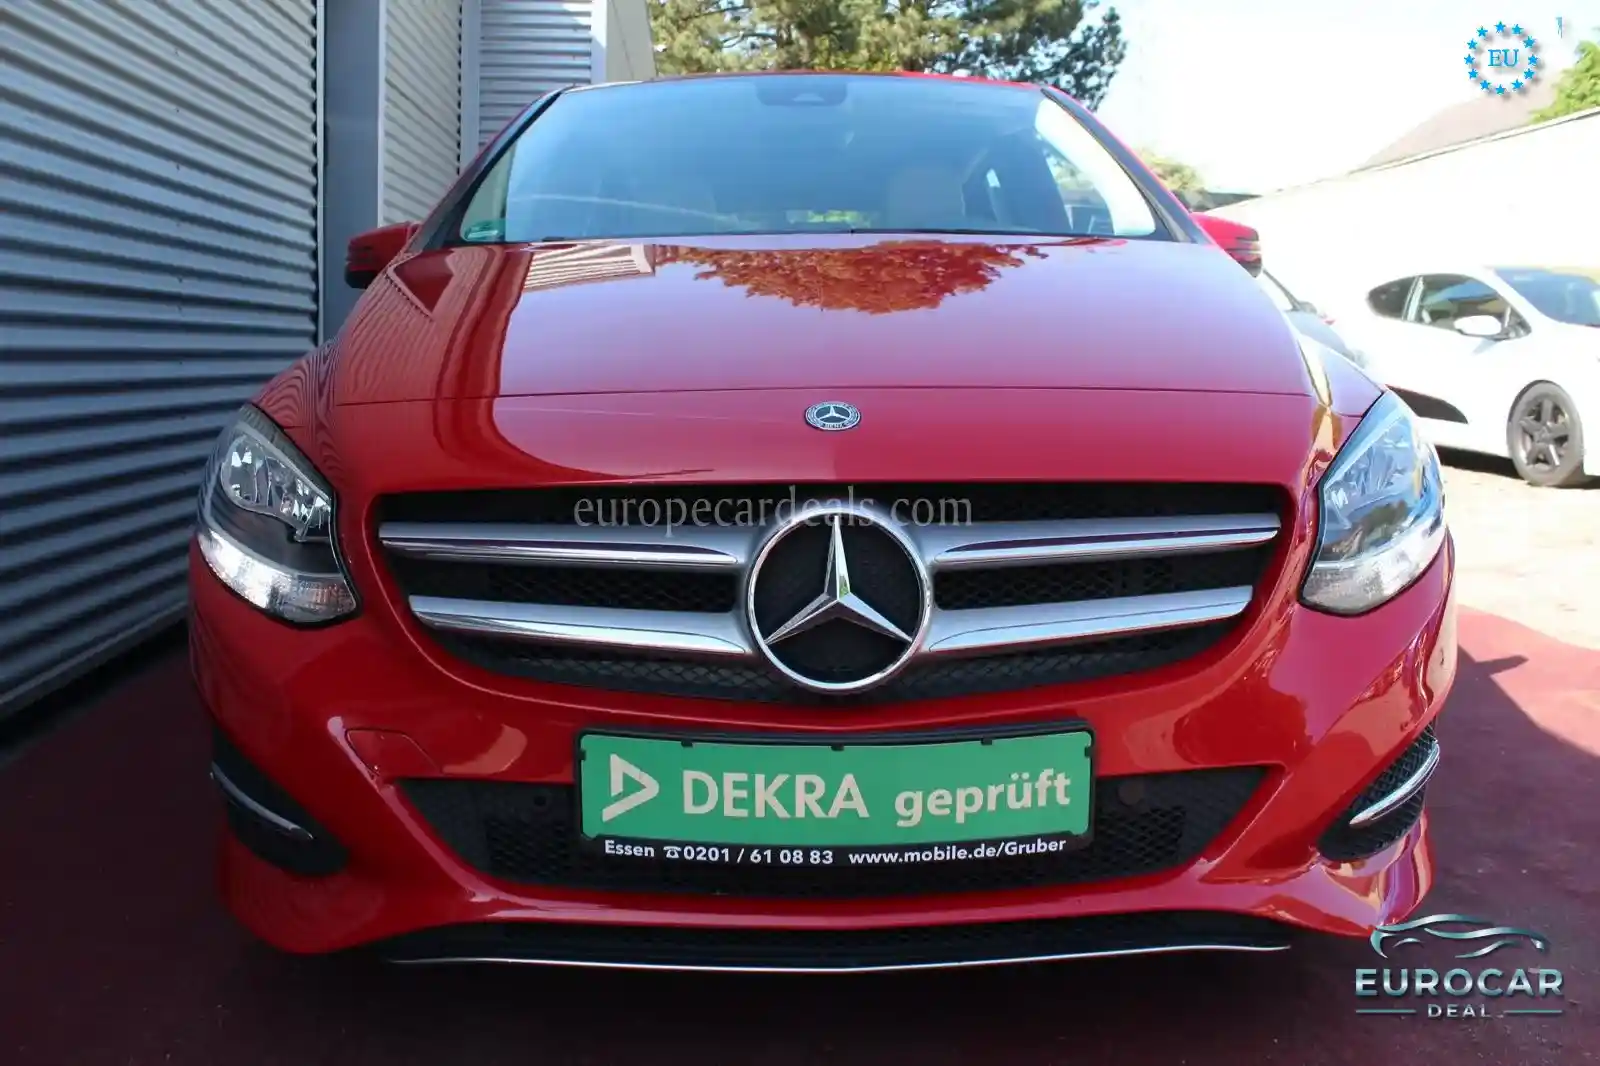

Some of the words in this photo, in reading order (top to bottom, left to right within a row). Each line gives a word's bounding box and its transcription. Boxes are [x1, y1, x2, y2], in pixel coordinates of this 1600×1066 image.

[682, 770, 870, 819] DEKRA
[894, 768, 1071, 828] geprüft
[604, 839, 655, 857] Essen
[683, 845, 730, 862] 0201
[749, 848, 772, 864] 61
[779, 849, 804, 865] 08
[809, 850, 834, 865] 83
[848, 838, 1067, 865] www.mobile.de/Gruber
